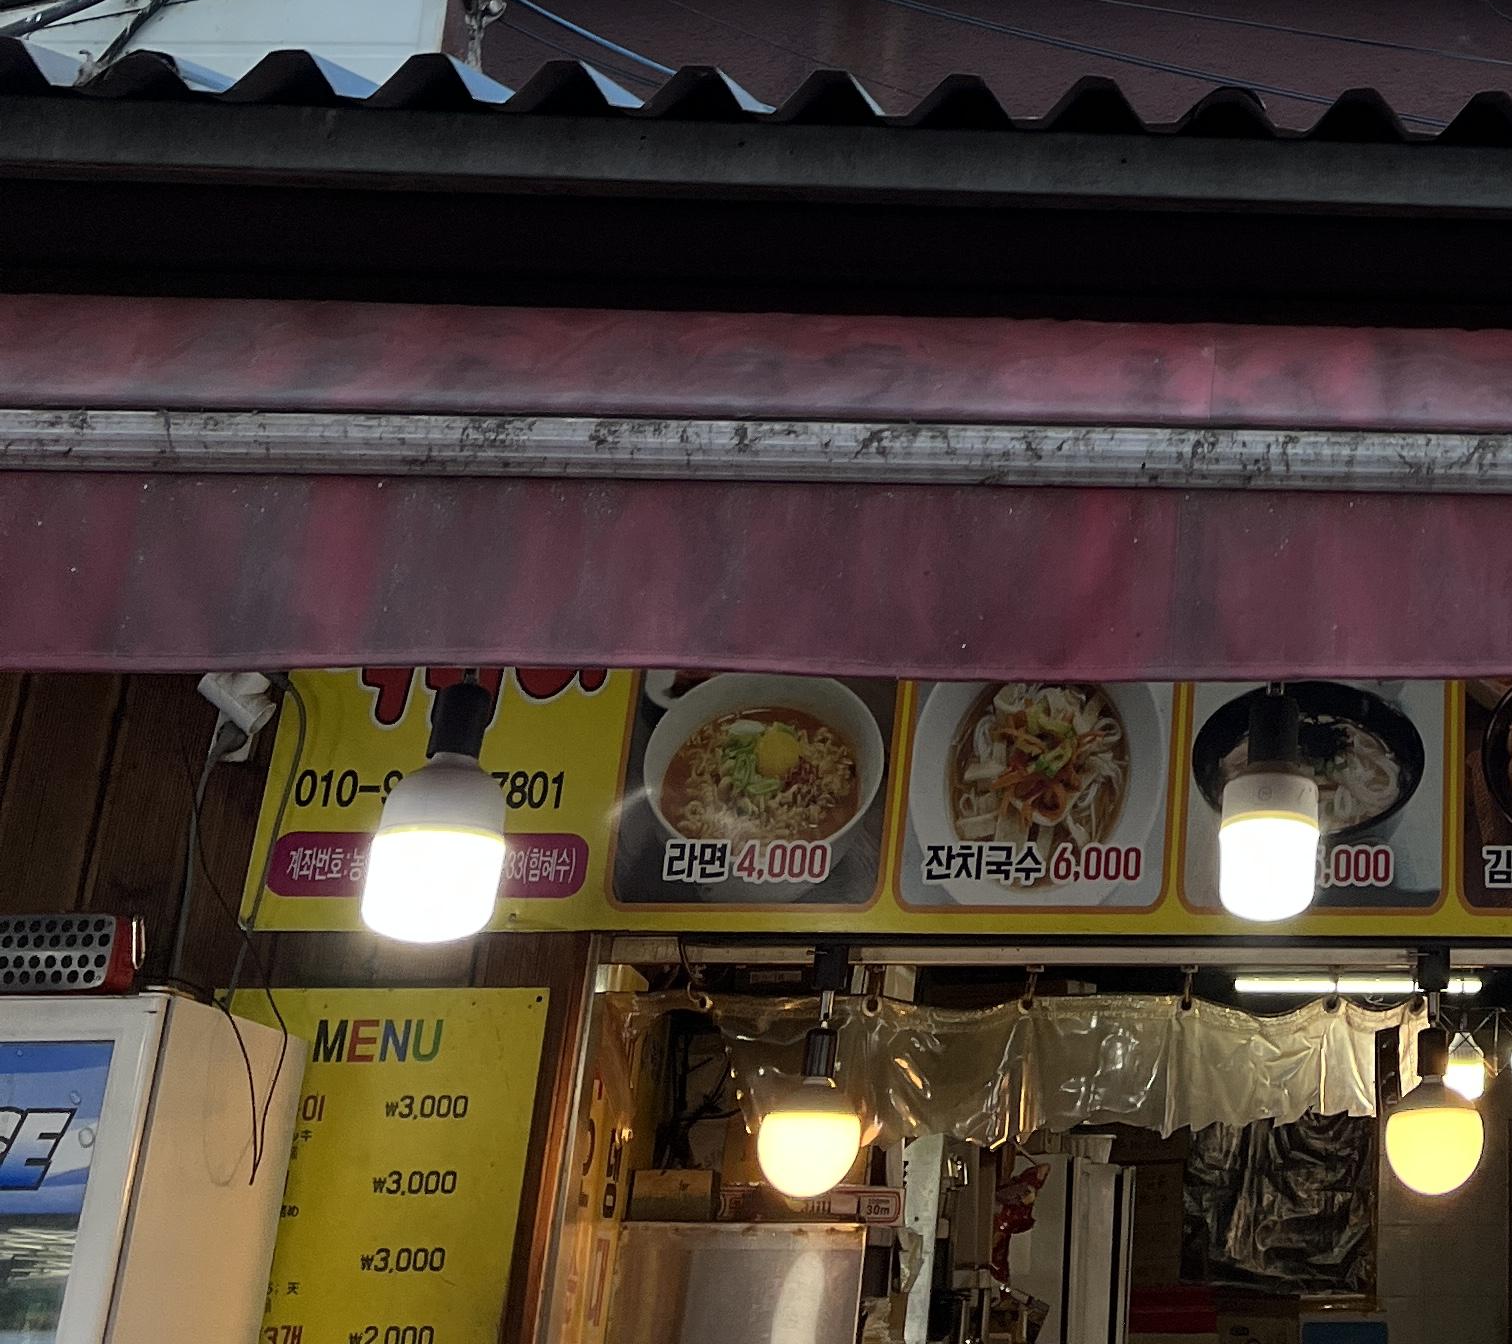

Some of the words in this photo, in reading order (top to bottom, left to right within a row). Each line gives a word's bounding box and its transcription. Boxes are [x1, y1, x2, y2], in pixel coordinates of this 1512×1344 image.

[663, 841, 728, 881] 라면
[735, 842, 829, 882] 4,000
[924, 843, 1044, 884] 잔치국수
[1051, 846, 1142, 884] 6,000
[1317, 847, 1391, 885] ,000
[311, 1018, 445, 1063] MENU
